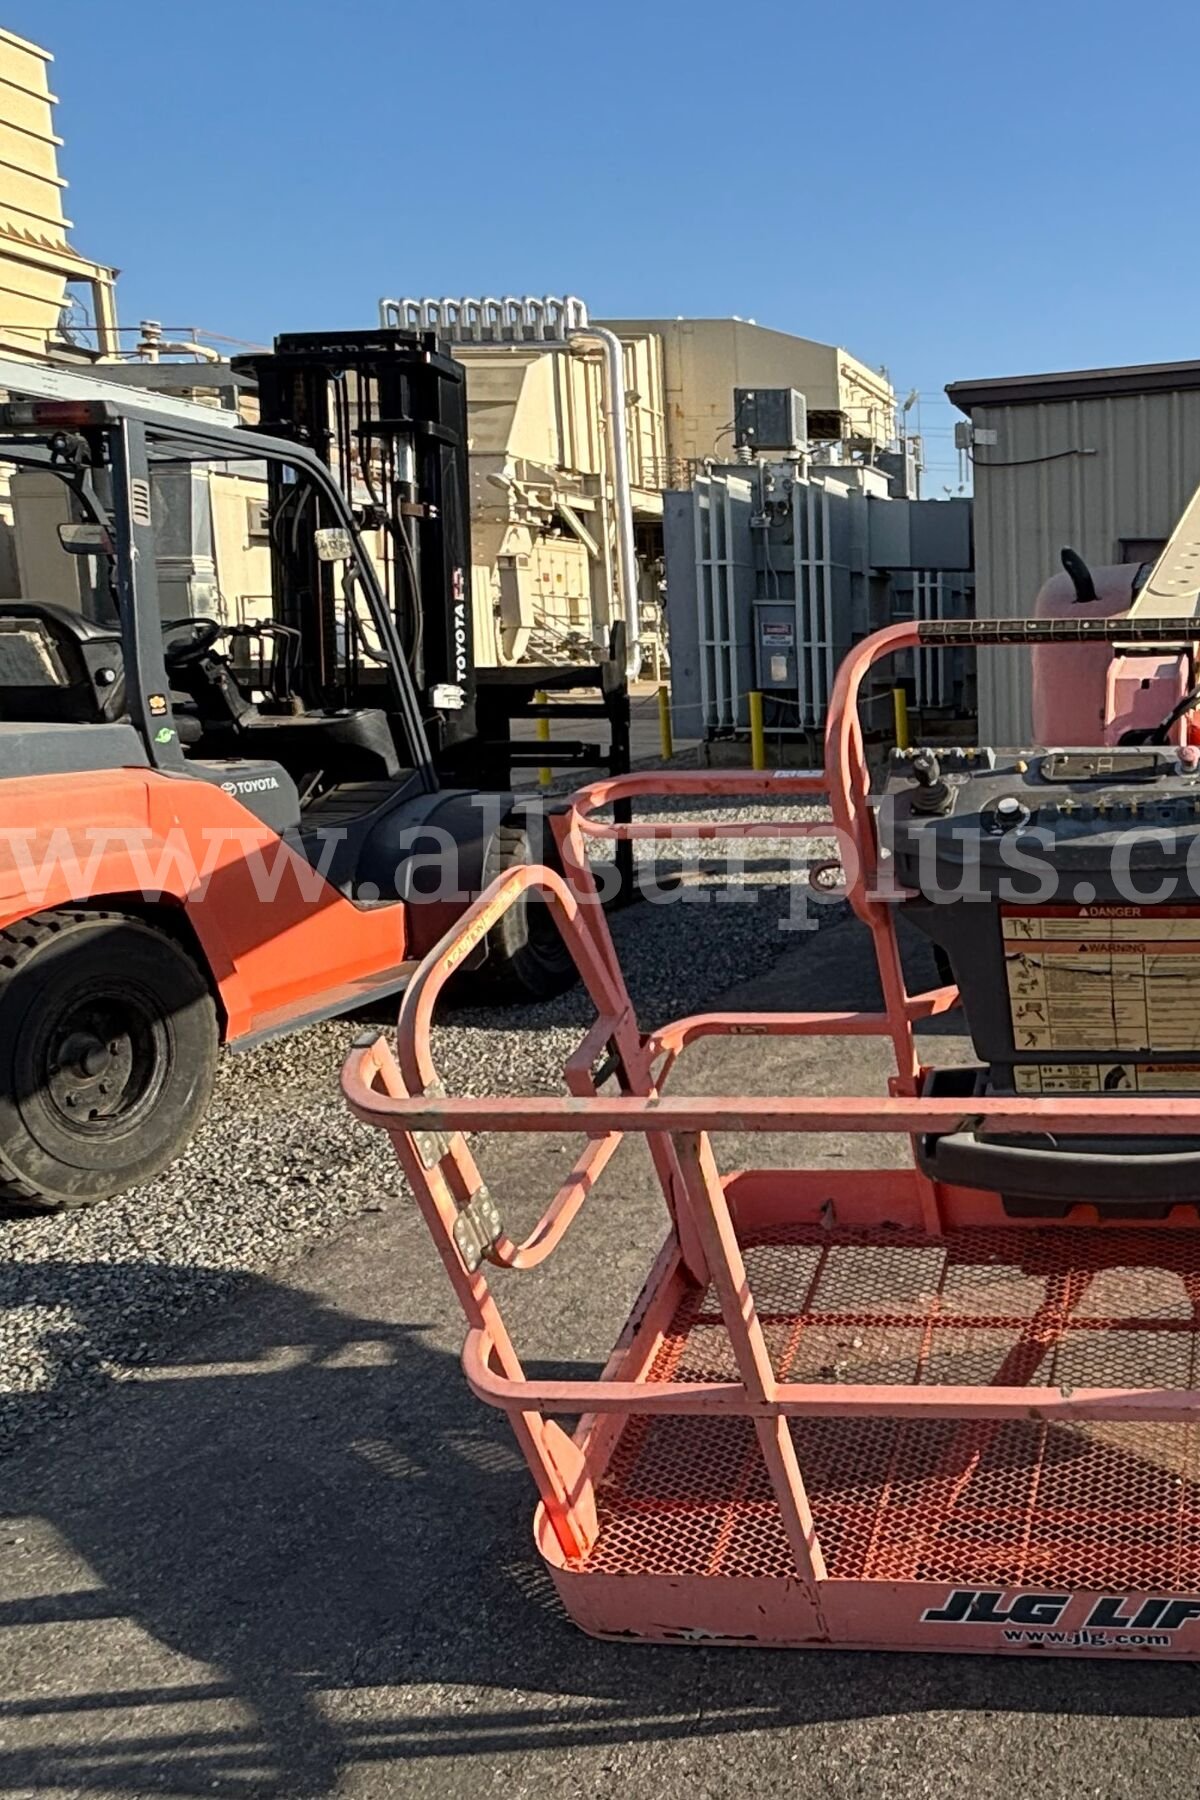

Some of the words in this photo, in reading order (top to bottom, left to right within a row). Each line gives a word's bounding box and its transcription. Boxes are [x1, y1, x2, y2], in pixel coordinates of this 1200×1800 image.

[454, 603, 467, 682] TOYOTA
[236, 776, 280, 794] TOYOTA
[1089, 906, 1142, 917] DANGER
[1088, 943, 1147, 953] WARNING
[921, 1589, 1073, 1626] JLG
[1003, 1628, 1171, 1647] www.jlg.com
